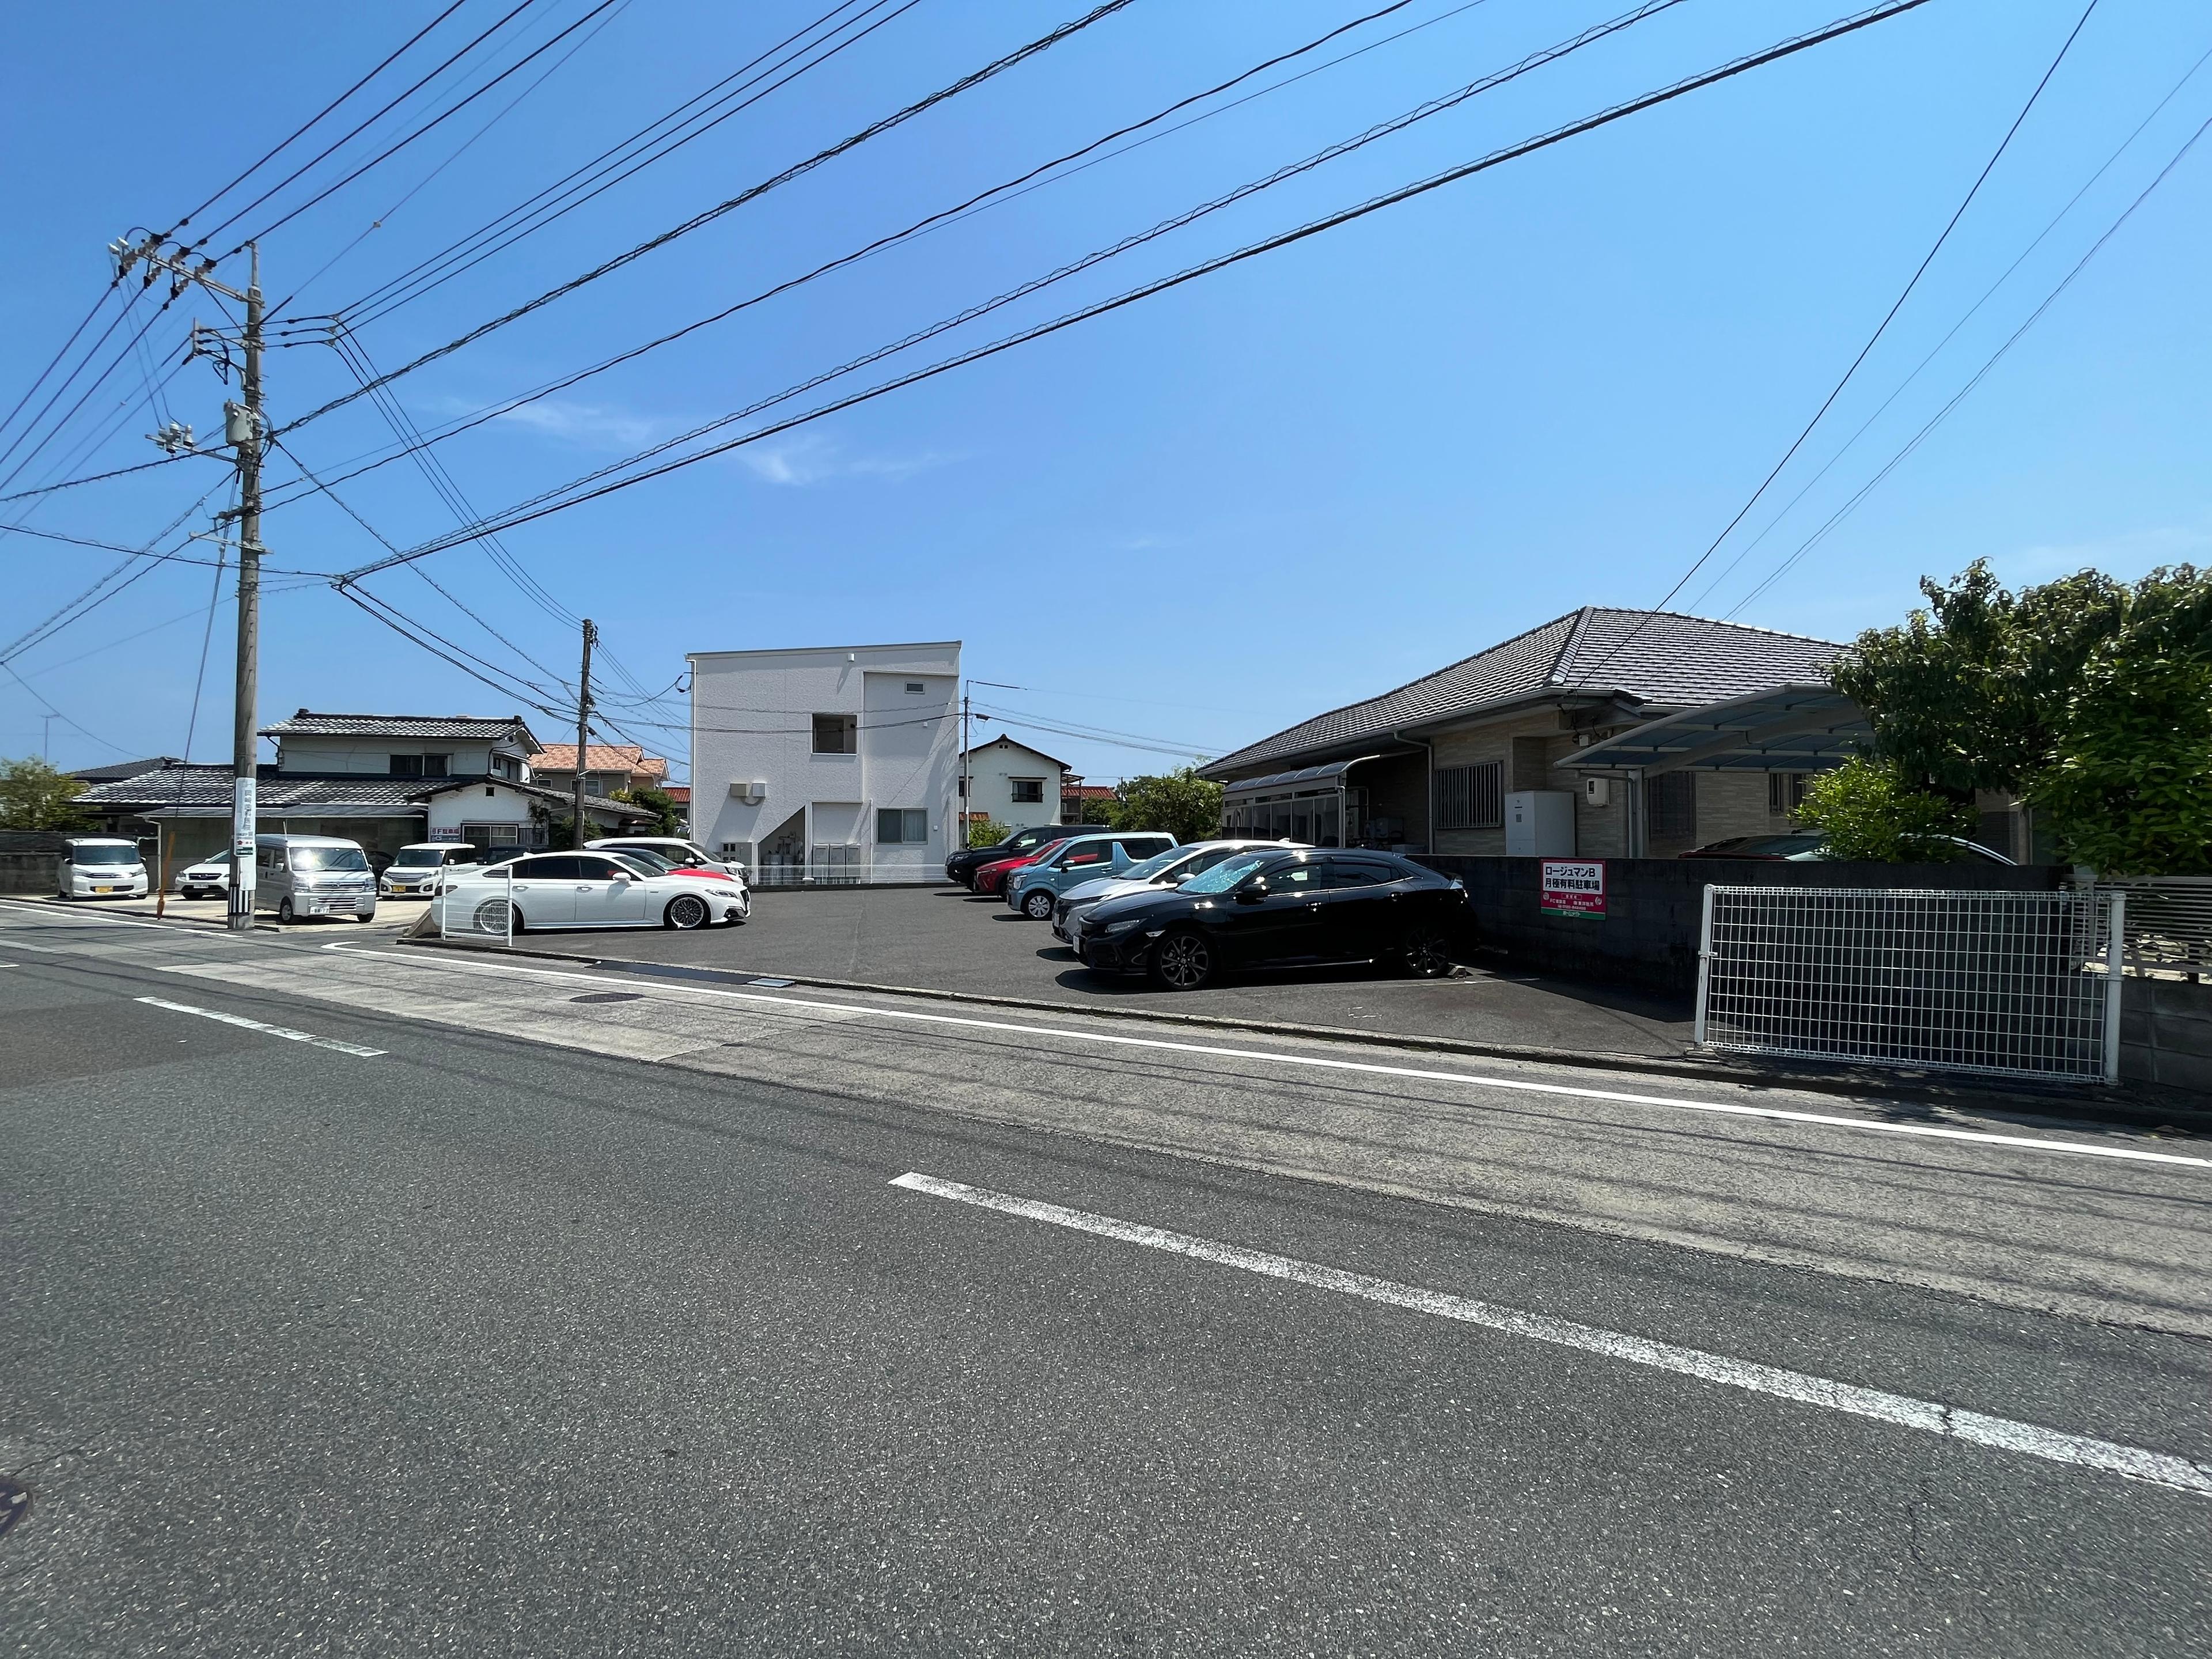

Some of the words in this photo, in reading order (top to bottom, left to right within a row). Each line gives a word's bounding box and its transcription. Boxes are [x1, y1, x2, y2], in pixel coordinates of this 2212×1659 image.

[1545, 866, 1596, 877] ロージュマンB
[1545, 878, 1600, 891] 月極有料駐車場
